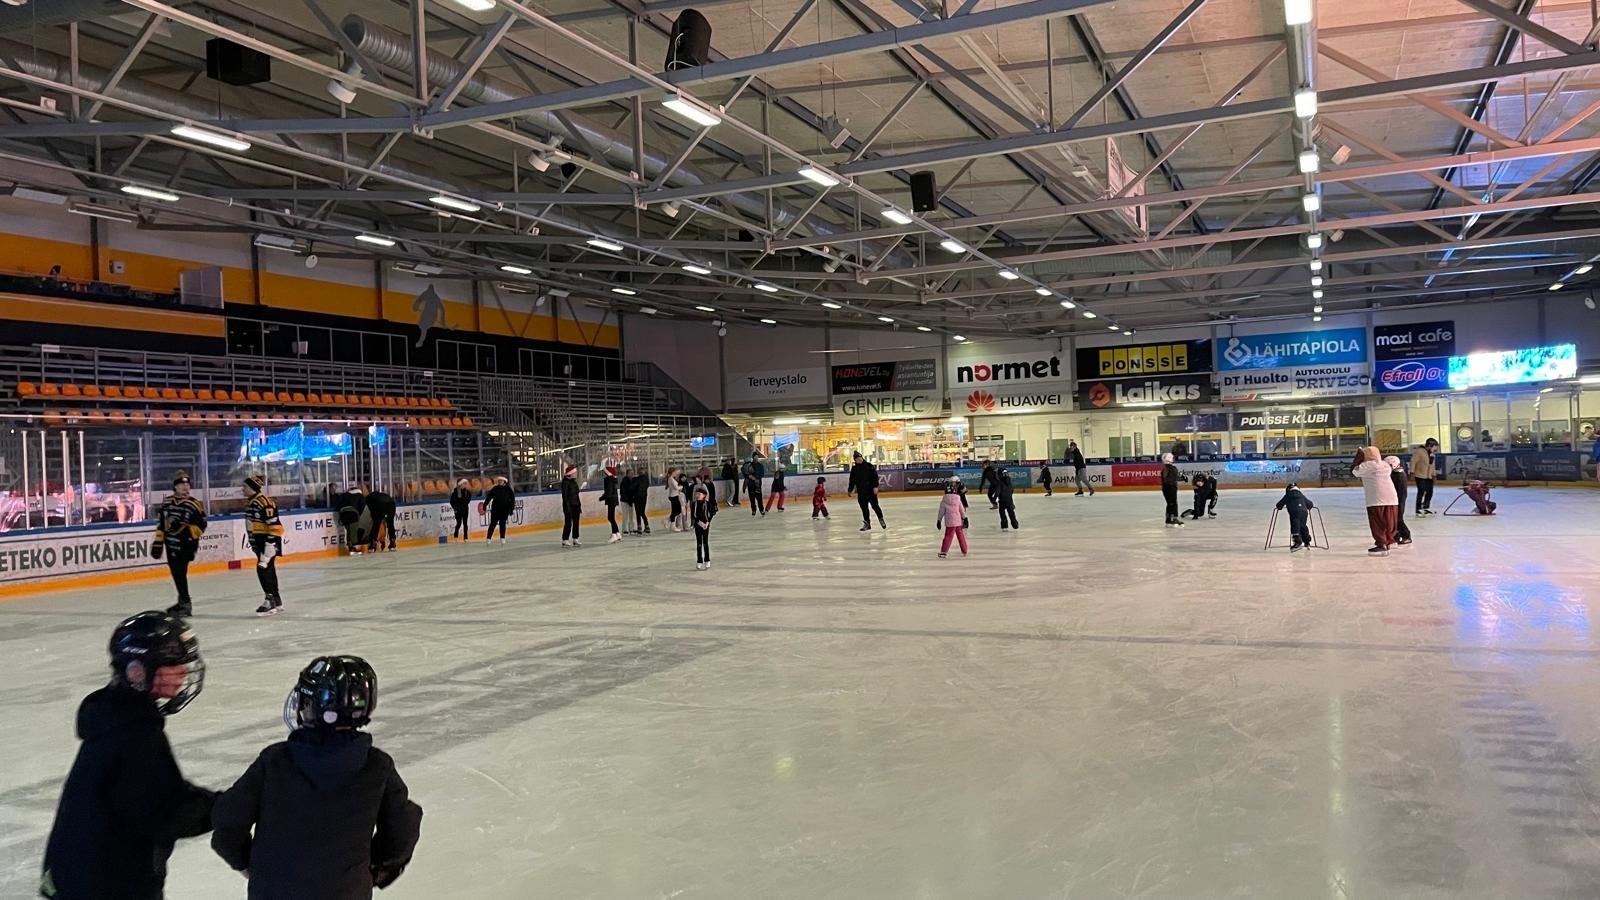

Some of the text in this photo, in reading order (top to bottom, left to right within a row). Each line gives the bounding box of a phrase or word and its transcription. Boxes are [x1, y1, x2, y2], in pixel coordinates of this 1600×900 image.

[1376, 328, 1453, 346] maxi cafe
[1255, 339, 1360, 357] LÄHITAPIOLA
[957, 356, 1060, 383] normet
[1102, 356, 1185, 371] PONSSE
[1295, 367, 1350, 376] AUTOKOULU
[748, 374, 807, 388] Terveystalo
[1224, 373, 1289, 386] DT Huolto
[1296, 375, 1369, 389] DRIVEGO
[1115, 381, 1200, 403] Laikas
[842, 396, 924, 416] GENELEC
[1001, 395, 1061, 407] HUAWEI
[1241, 413, 1328, 426] PONSSE KLUBI
[1118, 470, 1162, 478] CITYMARKE
[62, 539, 148, 566] PITKÄNEN
